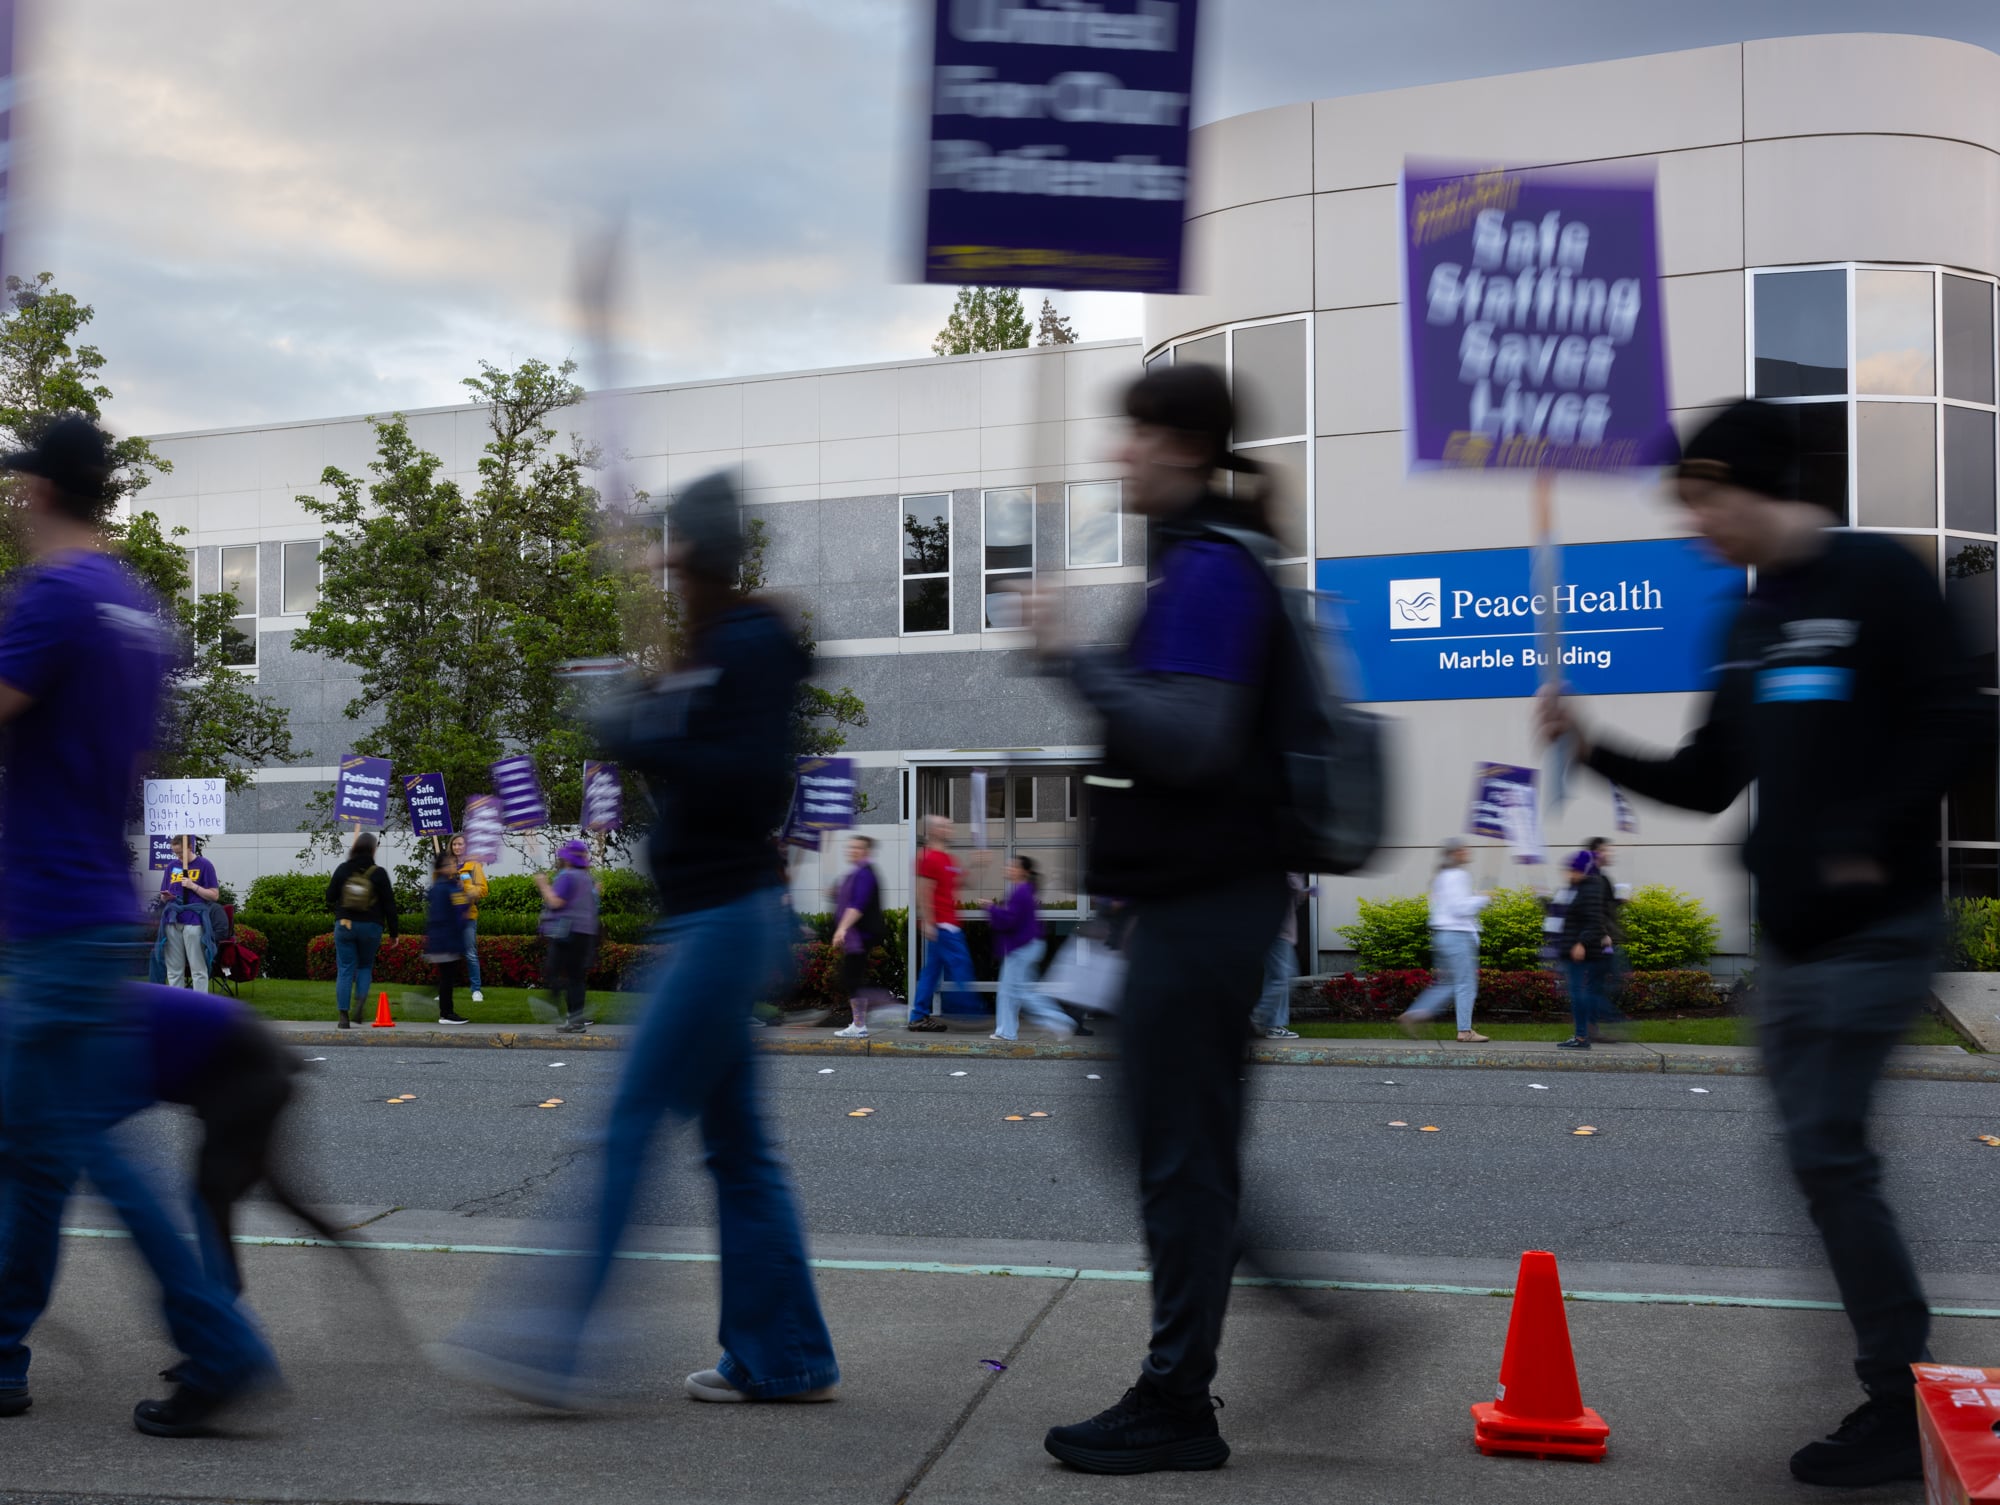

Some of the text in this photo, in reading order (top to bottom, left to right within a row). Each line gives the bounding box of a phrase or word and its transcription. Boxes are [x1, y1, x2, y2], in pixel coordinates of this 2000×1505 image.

[1472, 207, 1590, 275] Safe
[1426, 262, 1641, 346] Staffing
[1458, 320, 1616, 390] Saves
[1468, 377, 1612, 446] Lives
[1439, 646, 1612, 670] Marble Bulding
[343, 772, 386, 786] Patients
[344, 785, 380, 798] Before
[416, 784, 434, 794] Safe
[202, 795, 222, 805] BAD
[343, 797, 379, 810] Profits
[411, 796, 445, 807] Staffing
[199, 812, 221, 826] here
[418, 808, 442, 817] Saves
[421, 819, 443, 828] Lives
[171, 869, 200, 883] SEU
